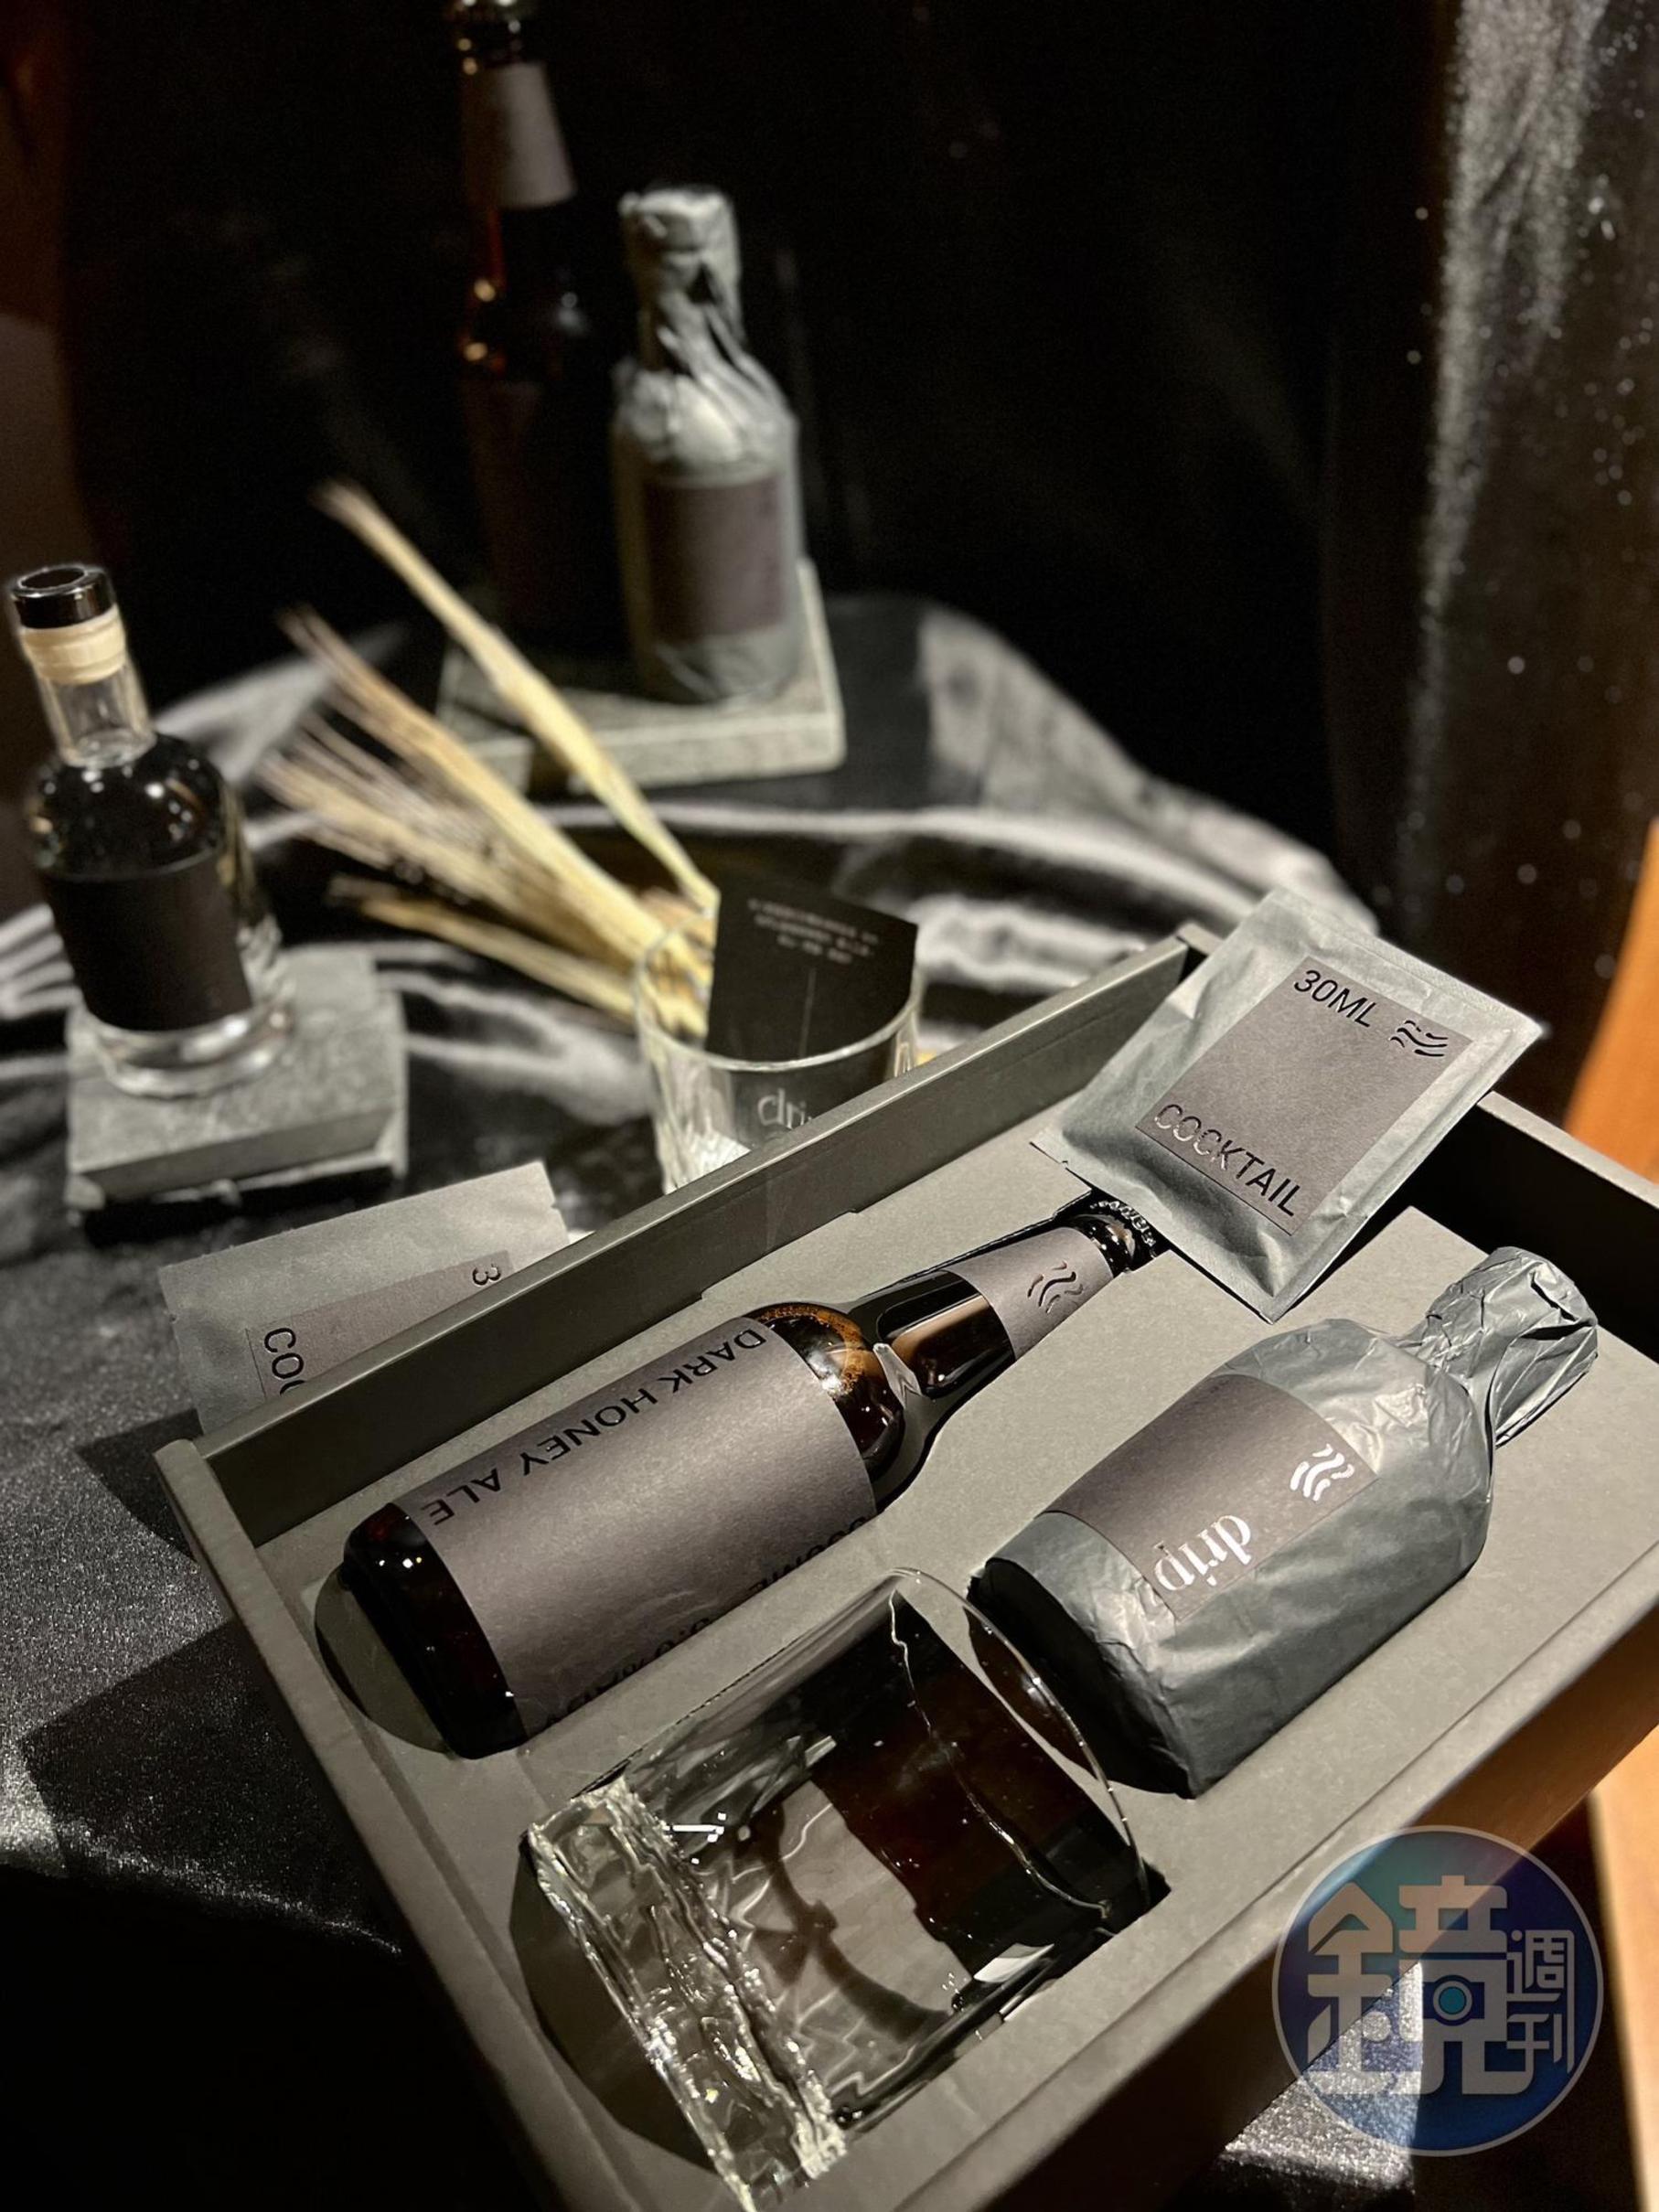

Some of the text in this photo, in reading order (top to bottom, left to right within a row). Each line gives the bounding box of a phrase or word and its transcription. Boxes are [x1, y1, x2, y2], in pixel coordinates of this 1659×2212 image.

[1293, 968, 1376, 1028] 30ML
[1154, 1104, 1301, 1217] COCKTAIL
[421, 1328, 767, 1526] DARK HONEY ALE
[1153, 1514, 1252, 1591] drip
